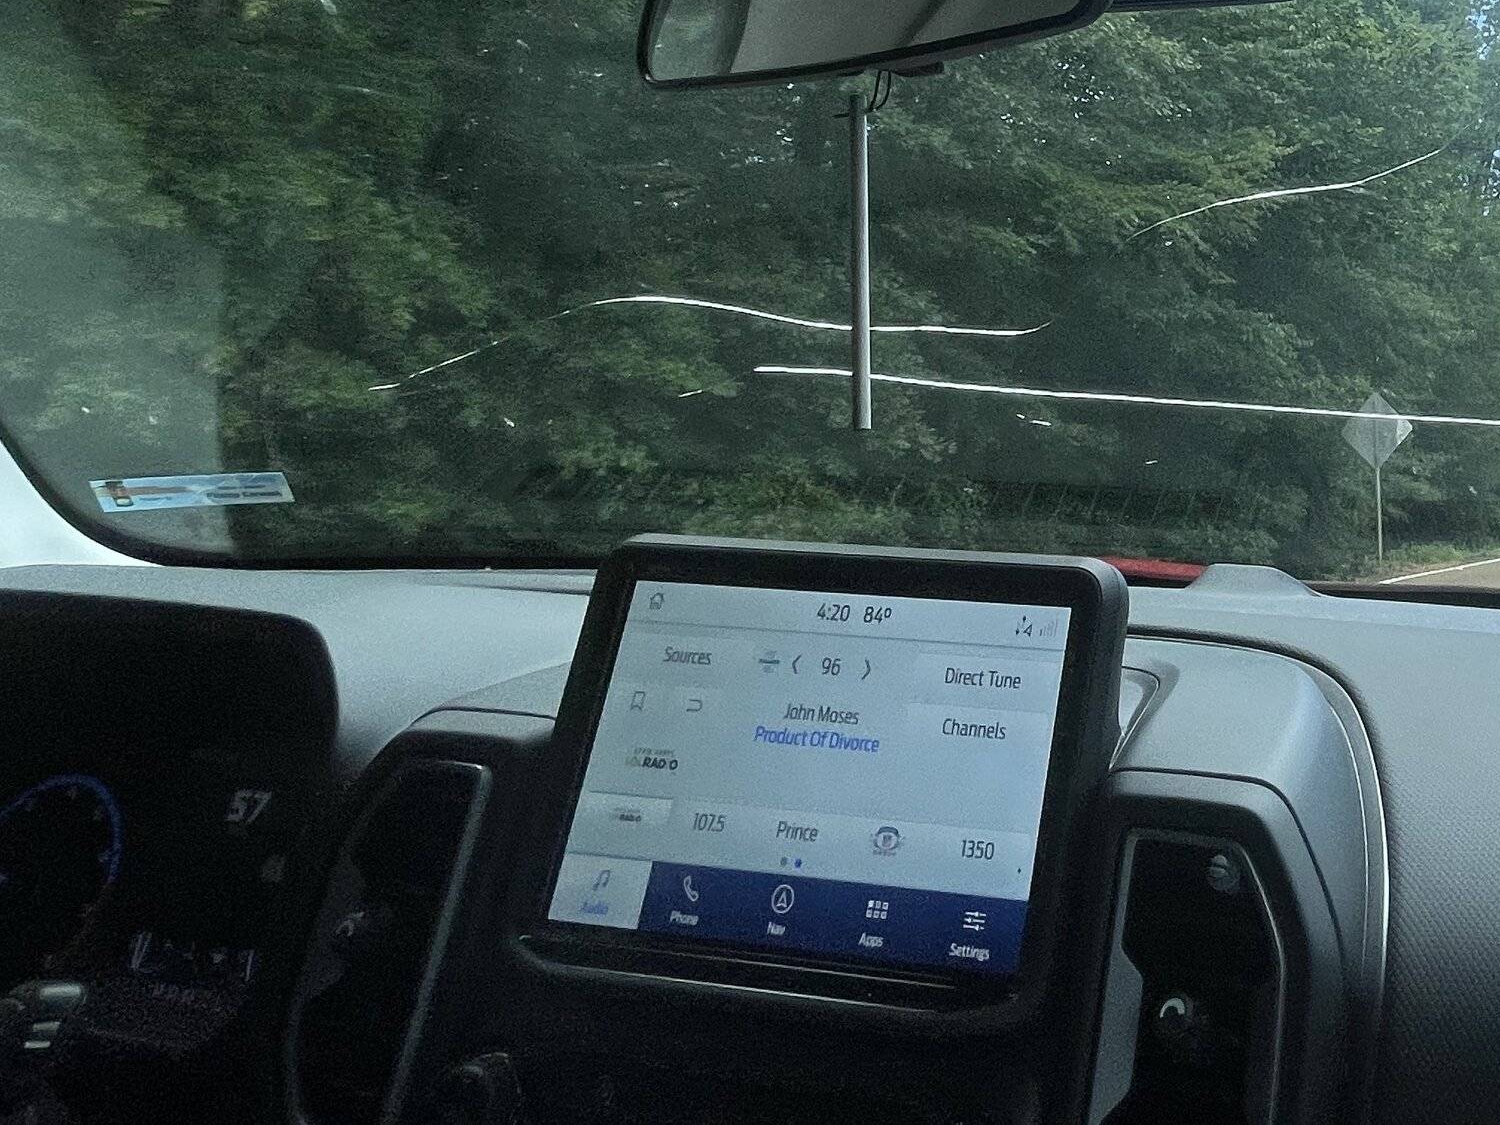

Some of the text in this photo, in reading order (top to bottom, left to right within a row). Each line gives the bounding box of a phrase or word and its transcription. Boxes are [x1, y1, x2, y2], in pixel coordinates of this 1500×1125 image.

[816, 604, 850, 623] 4:20
[662, 645, 712, 667] Sources
[821, 657, 841, 676] 96
[944, 667, 1022, 689] Direct Tune
[784, 703, 859, 725] John Moses
[753, 725, 880, 753] Product Of Divorce
[942, 717, 1006, 740] Channels
[225, 788, 273, 824] 57
[776, 821, 819, 843] Prince
[960, 840, 995, 861] 1350
[670, 910, 699, 928] Phone
[766, 921, 785, 936] Nav
[858, 931, 884, 949] Apps
[949, 942, 990, 961] Settings
